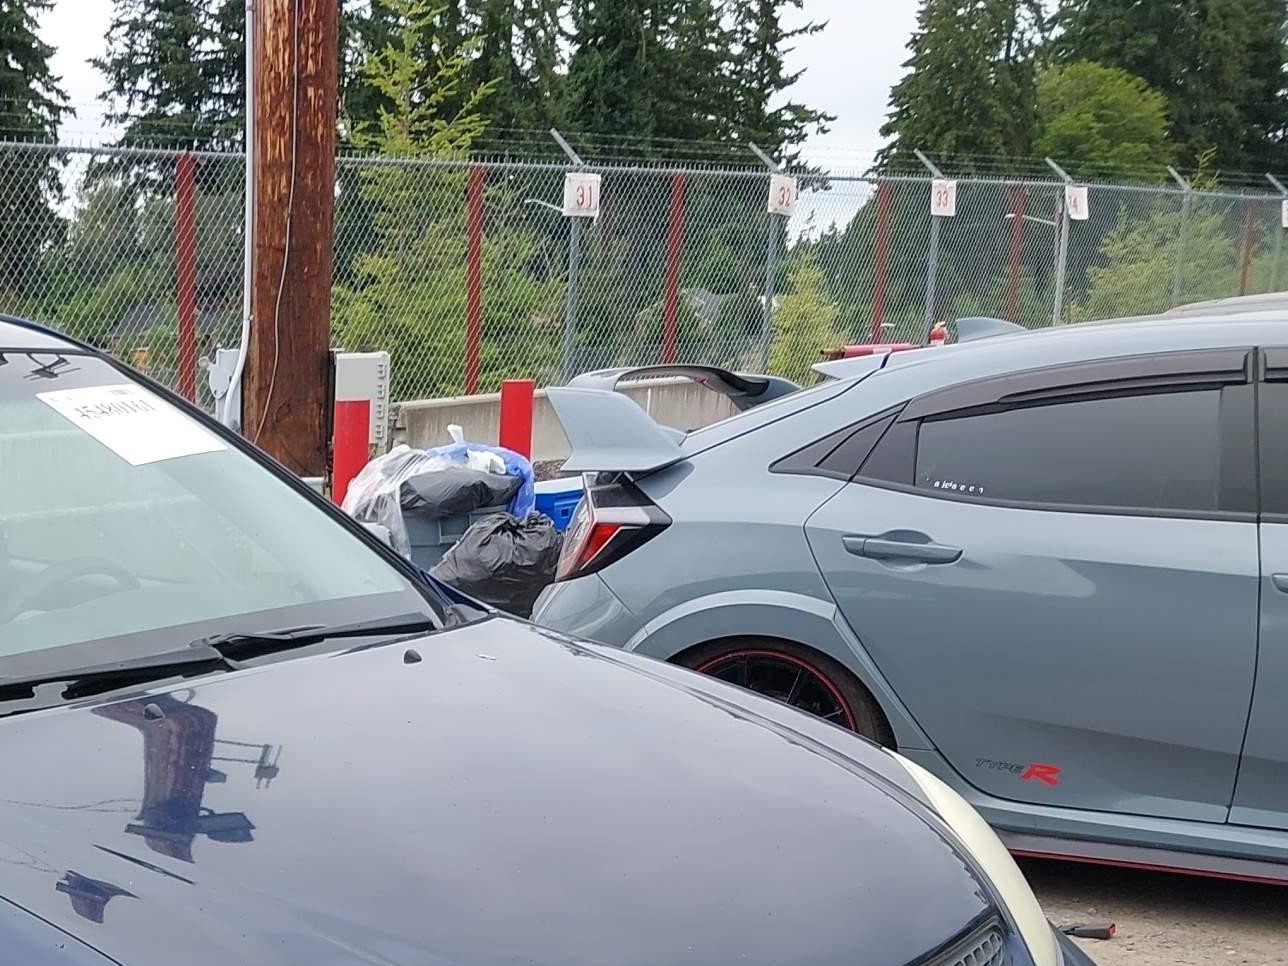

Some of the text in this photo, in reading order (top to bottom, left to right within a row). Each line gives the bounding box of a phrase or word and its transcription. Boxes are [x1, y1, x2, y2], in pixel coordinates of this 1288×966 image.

[576, 185, 593, 210] 31
[778, 186, 791, 207] 32
[935, 190, 949, 208] 33
[1020, 761, 1063, 786] R
